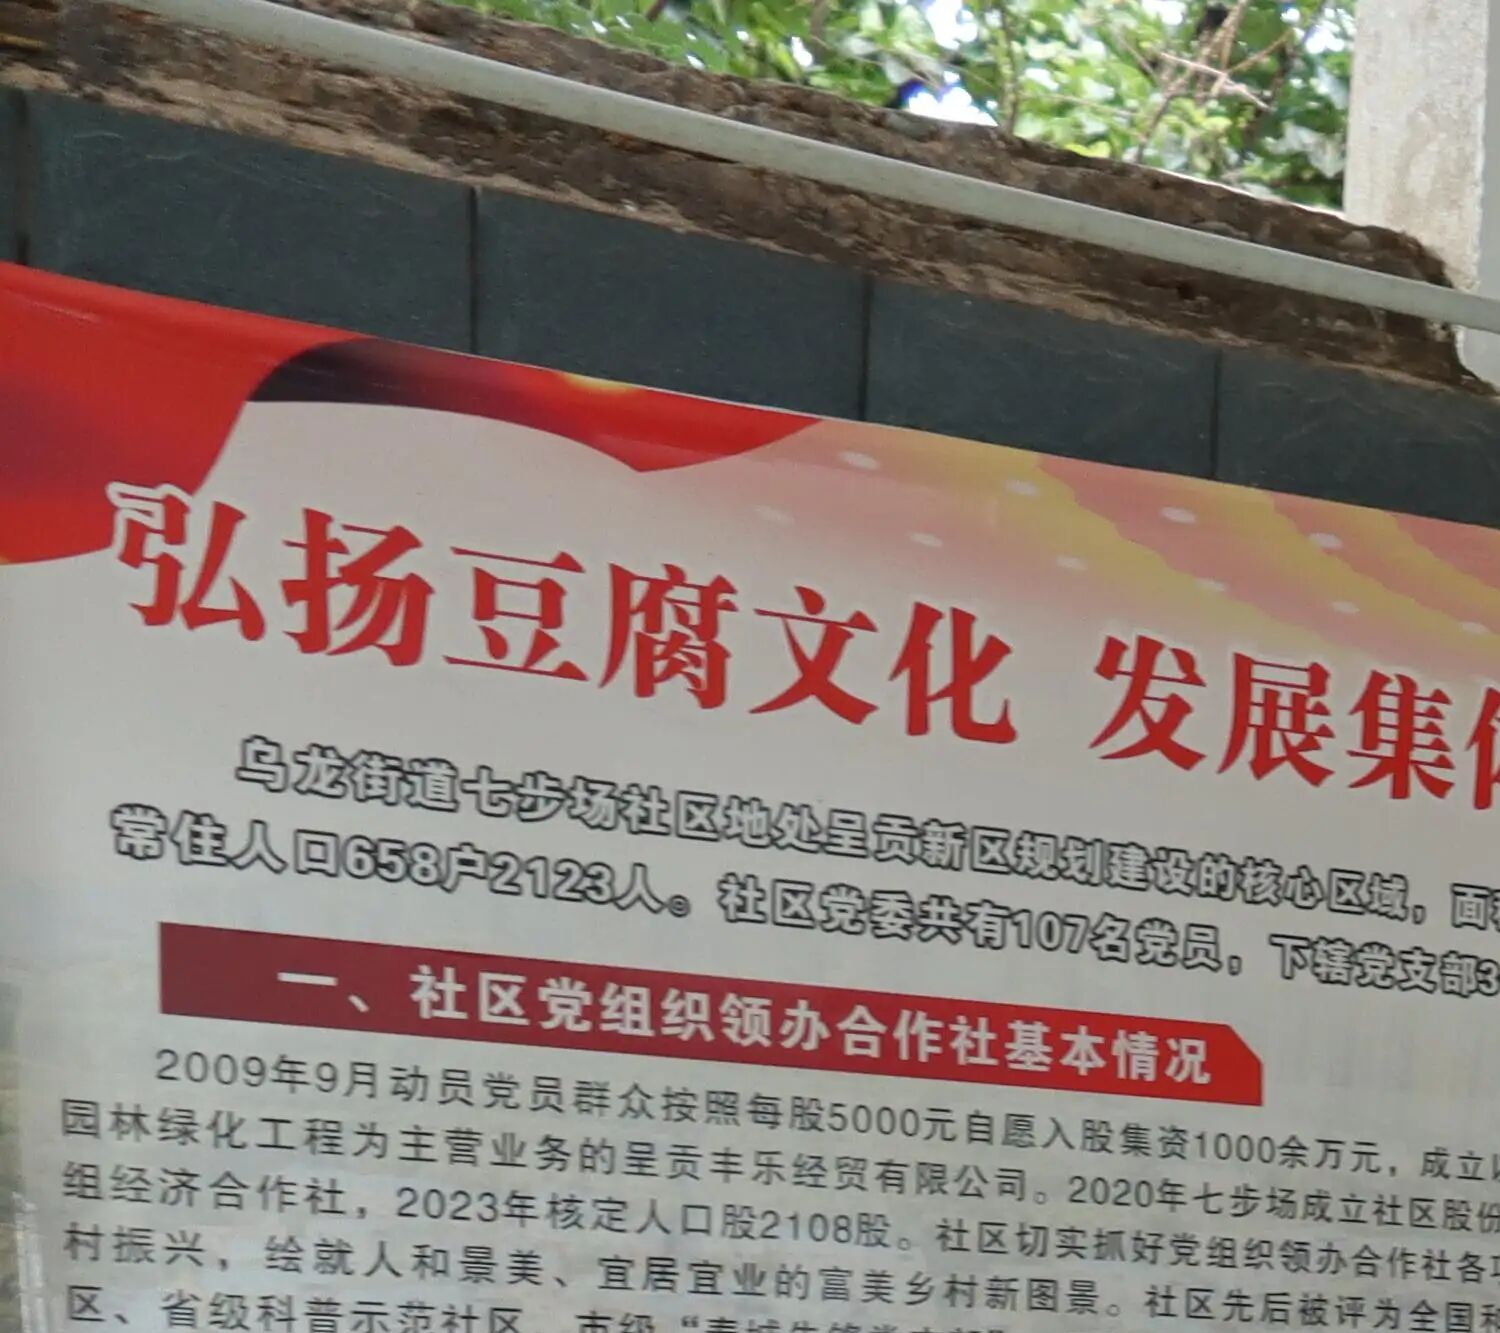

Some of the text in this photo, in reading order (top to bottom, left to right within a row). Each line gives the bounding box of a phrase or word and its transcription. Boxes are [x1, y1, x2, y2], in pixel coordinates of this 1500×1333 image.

[112, 488, 1015, 742] 弘扬豆腐文化
